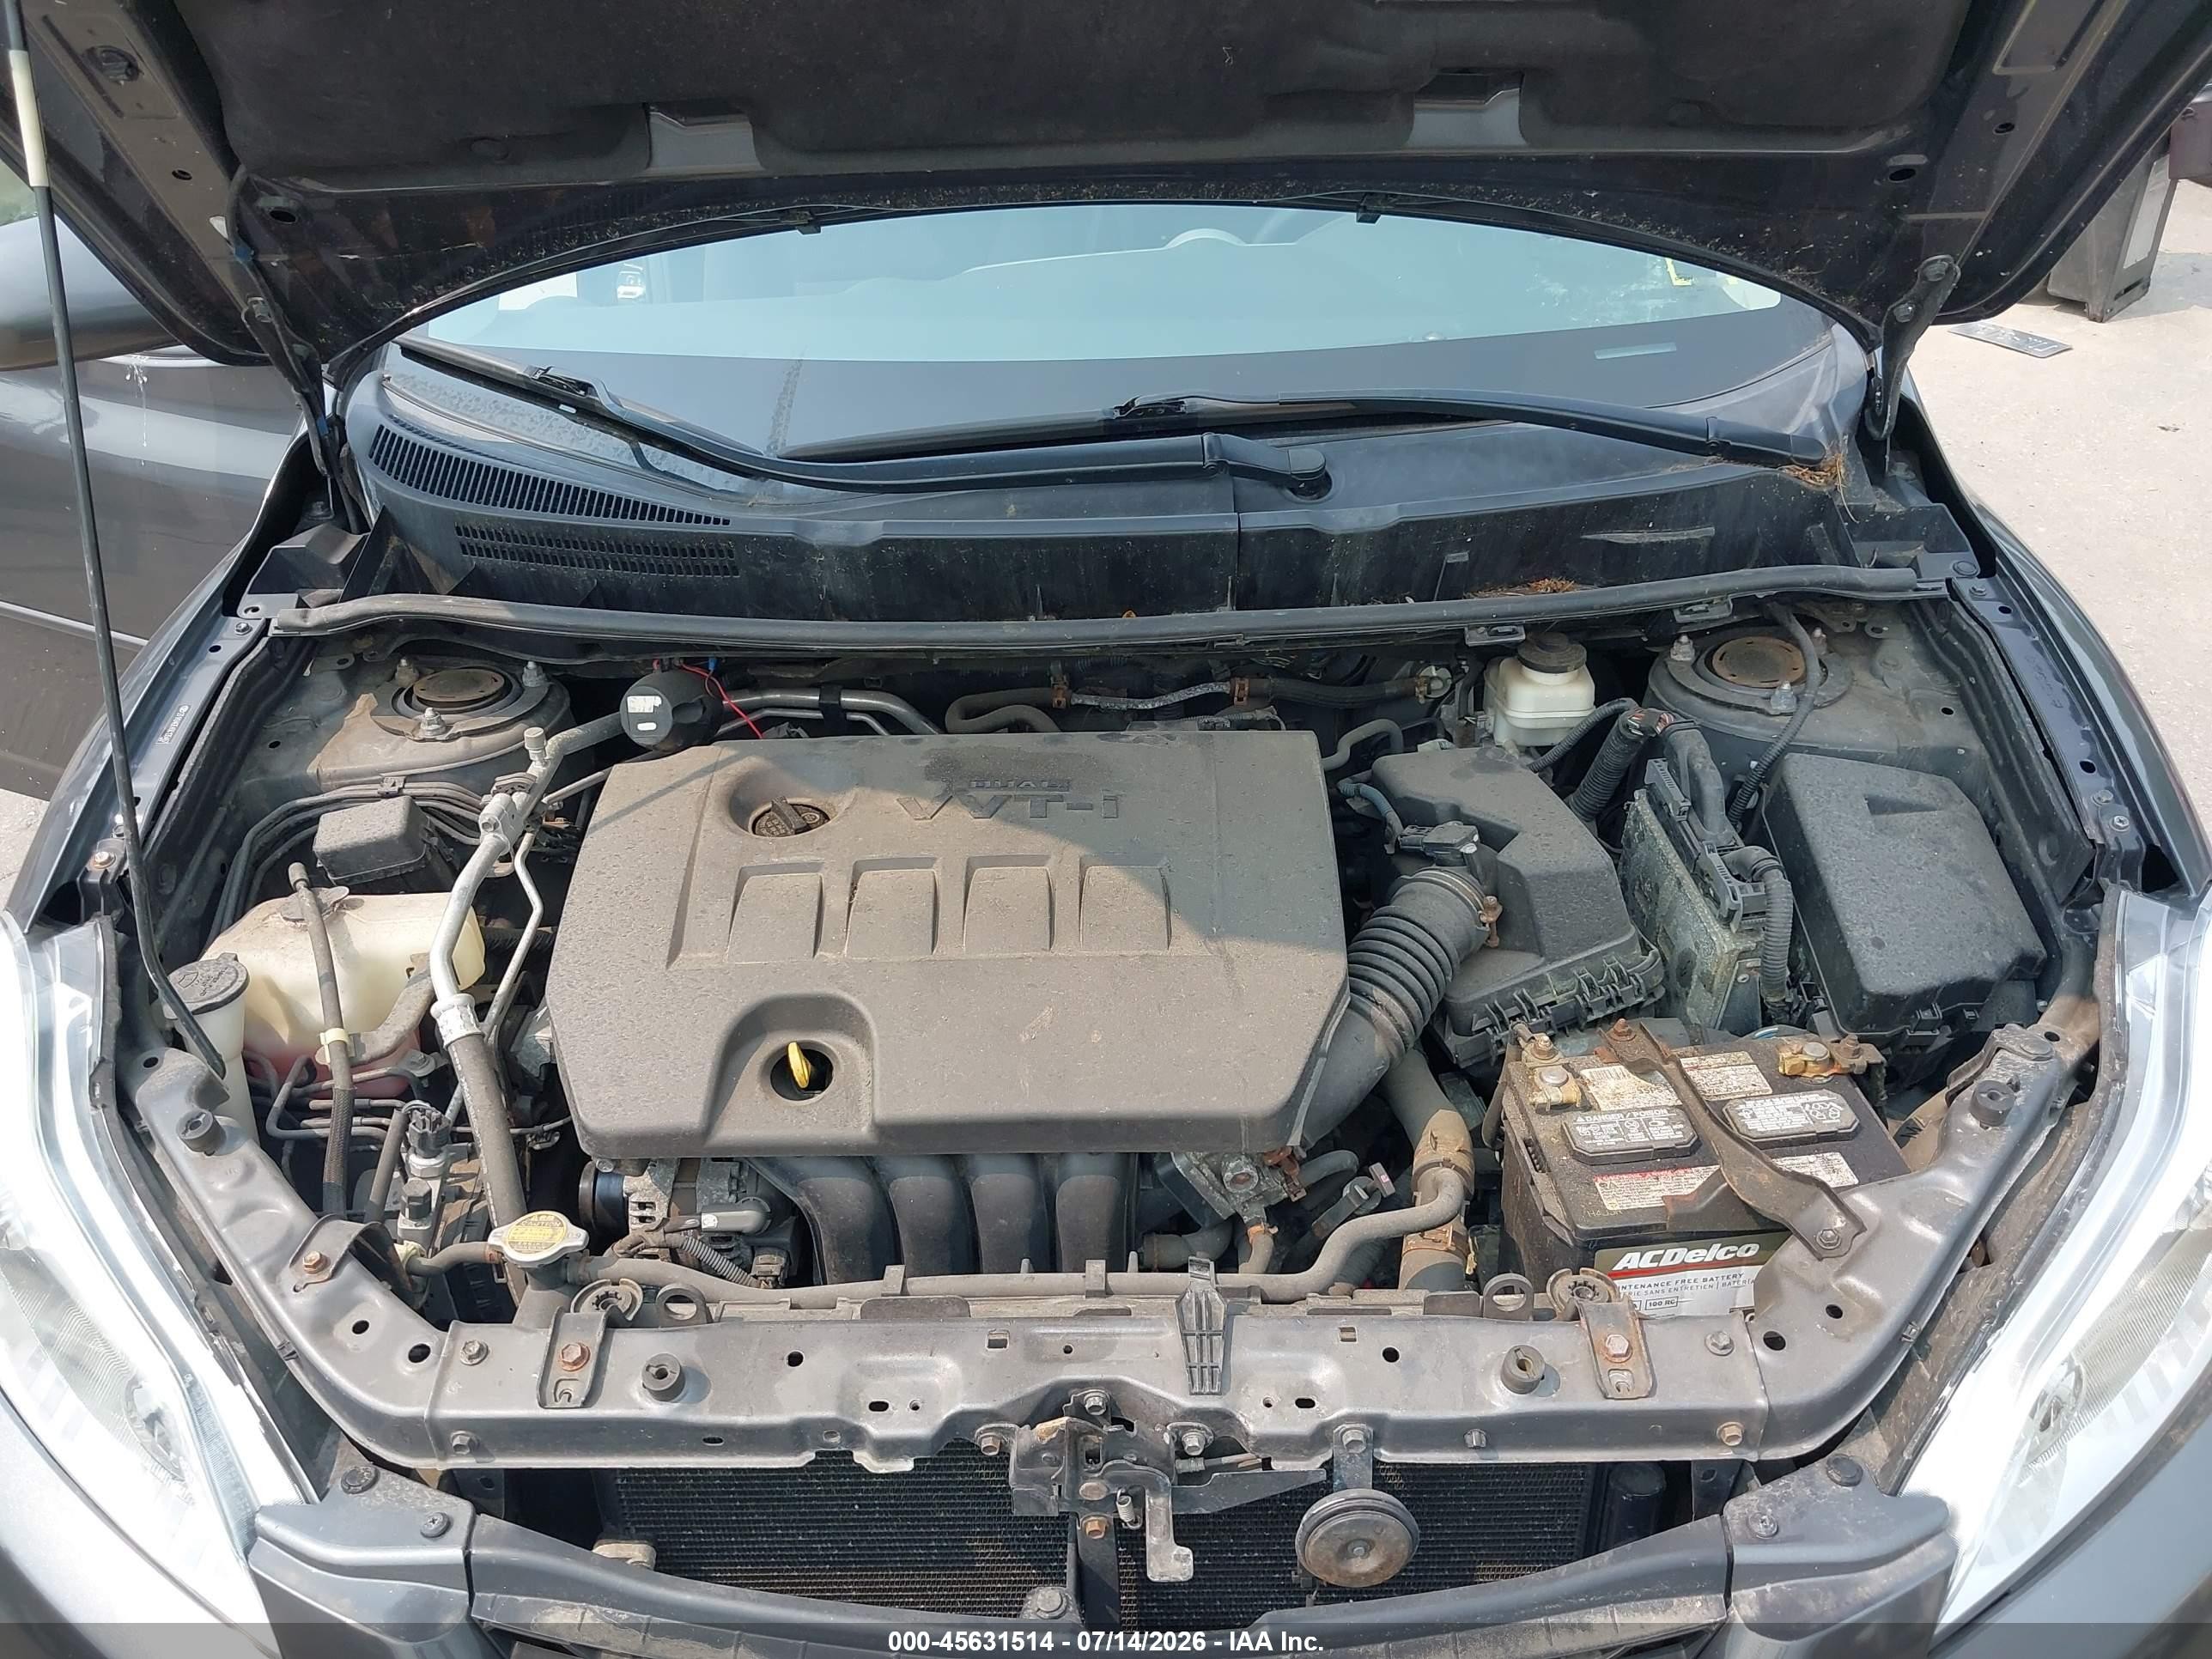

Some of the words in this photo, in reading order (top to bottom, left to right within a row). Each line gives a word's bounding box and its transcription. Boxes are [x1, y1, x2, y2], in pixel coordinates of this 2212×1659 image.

[1583, 1114, 1625, 1122] DANGER
[1633, 1109, 1668, 1119] POISON
[1612, 1243, 1760, 1271] ACDelco
[1702, 1273, 1744, 1283] BATTERY
[1668, 1284, 1714, 1293] ENTRETIEN
